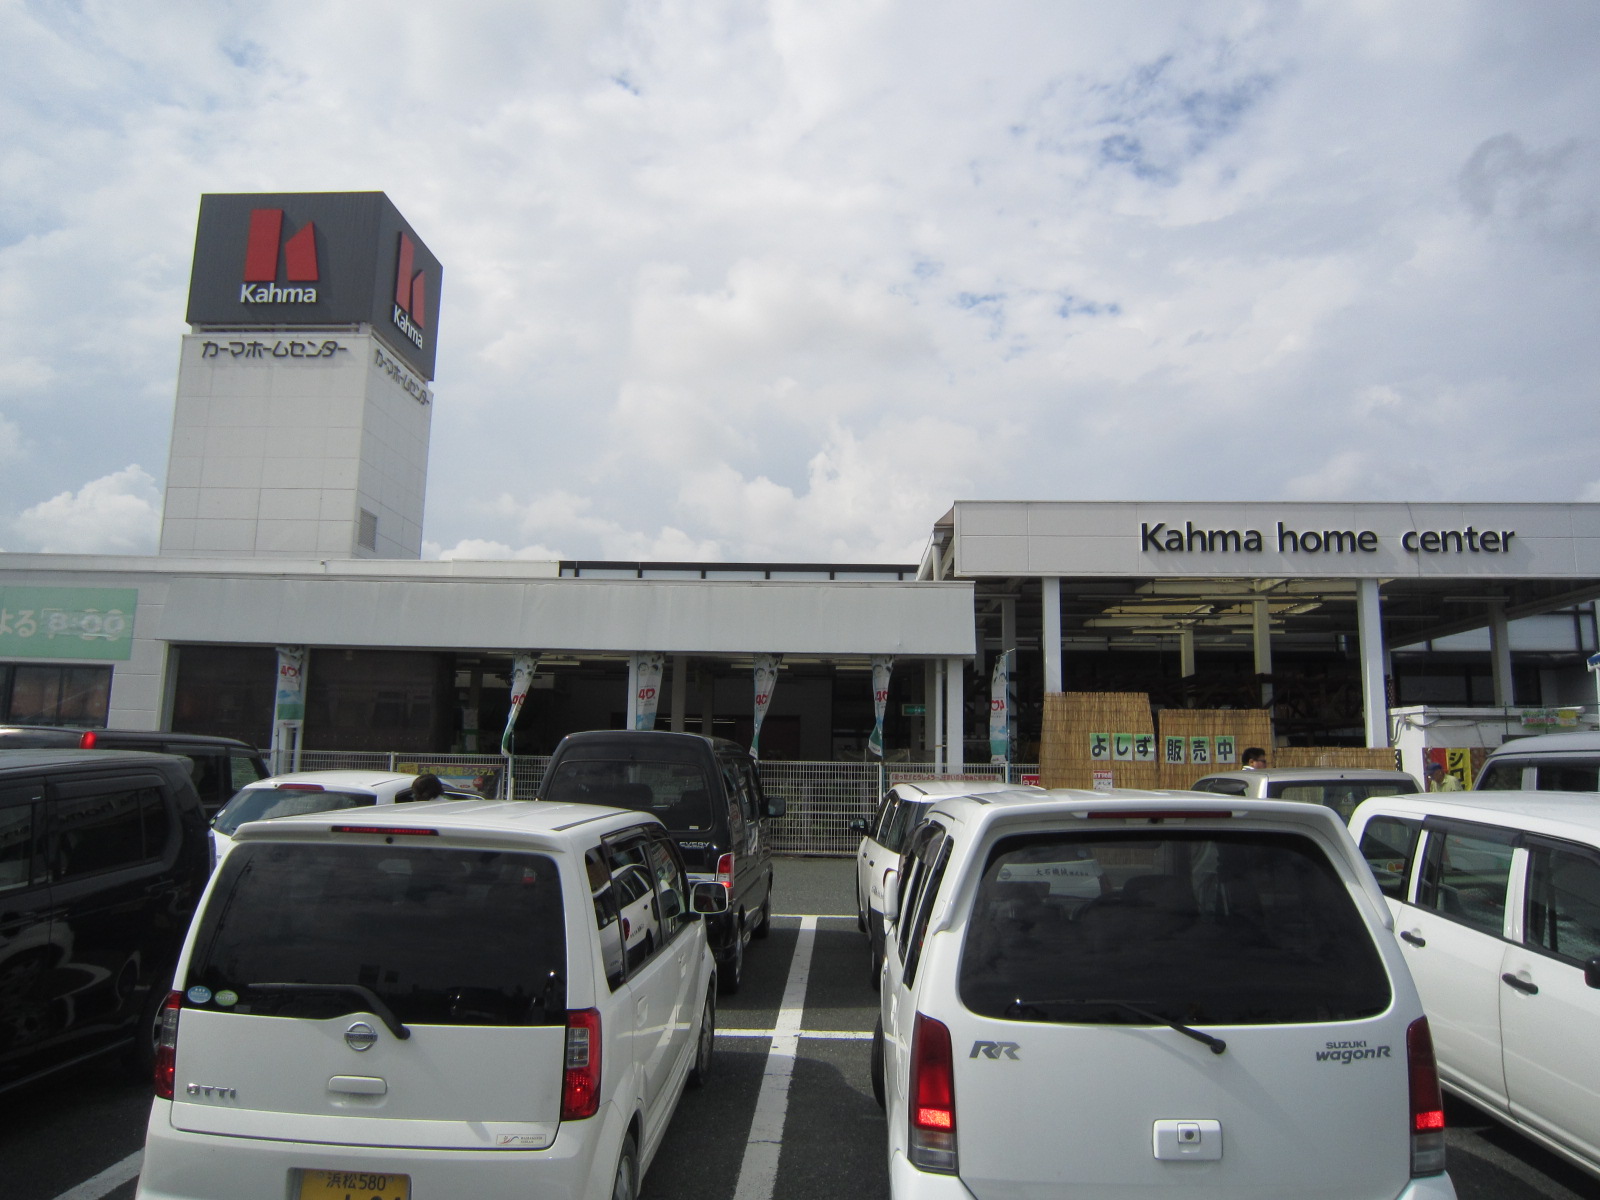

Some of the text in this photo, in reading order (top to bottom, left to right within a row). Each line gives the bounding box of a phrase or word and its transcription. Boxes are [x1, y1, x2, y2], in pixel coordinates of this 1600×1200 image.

[240, 283, 317, 303] Kahma
[393, 304, 423, 349] Kahma
[202, 341, 347, 359] カーマホームセンター
[1140, 521, 1515, 552] Kahma home center
[1091, 735, 1233, 761] よしず 販売中
[1449, 752, 1465, 790] シロ
[969, 1041, 1021, 1060] RR
[1326, 1041, 1367, 1049] SUZUKI
